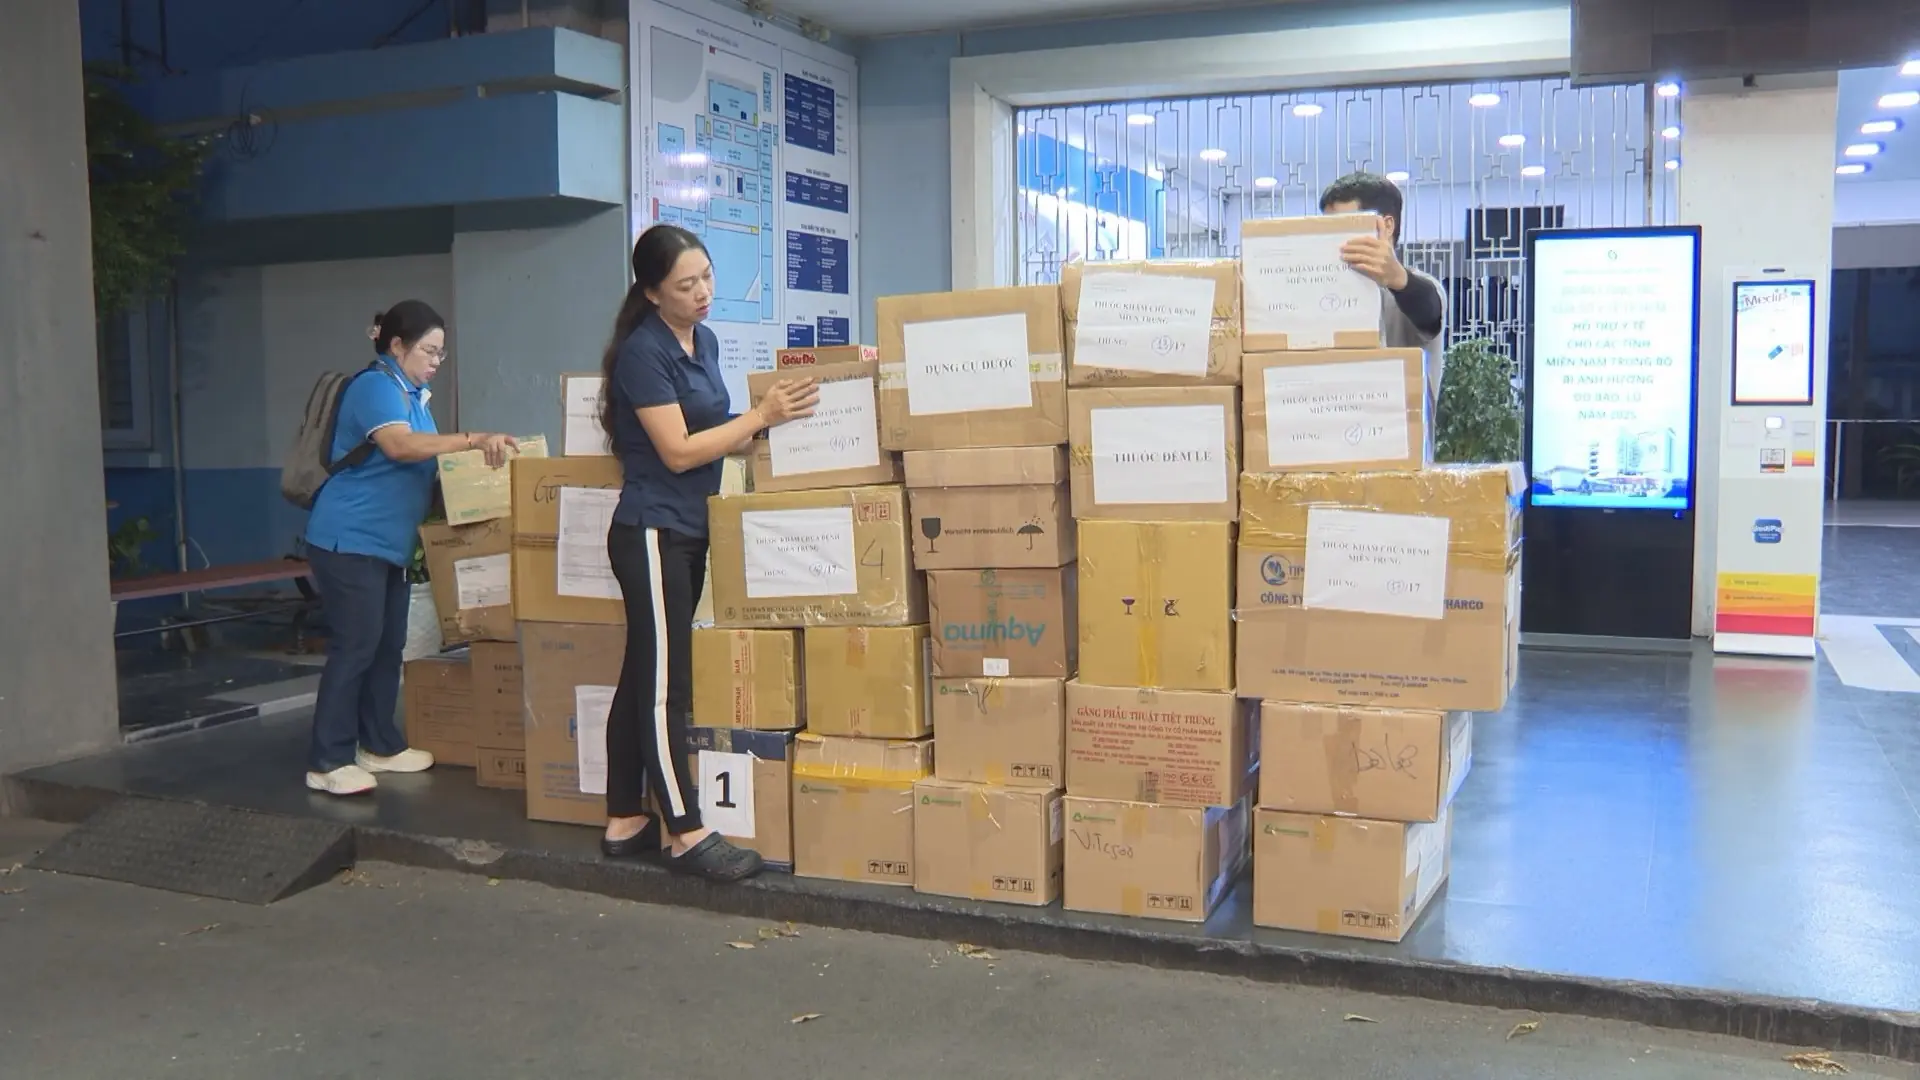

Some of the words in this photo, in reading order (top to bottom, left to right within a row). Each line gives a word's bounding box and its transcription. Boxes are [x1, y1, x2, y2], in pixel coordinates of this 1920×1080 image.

[860, 538, 885, 580] 4
[1260, 591, 1289, 605] CÔNG
[1445, 599, 1484, 611] HARCO
[943, 611, 1047, 648] Aquima
[715, 771, 737, 809] 1
